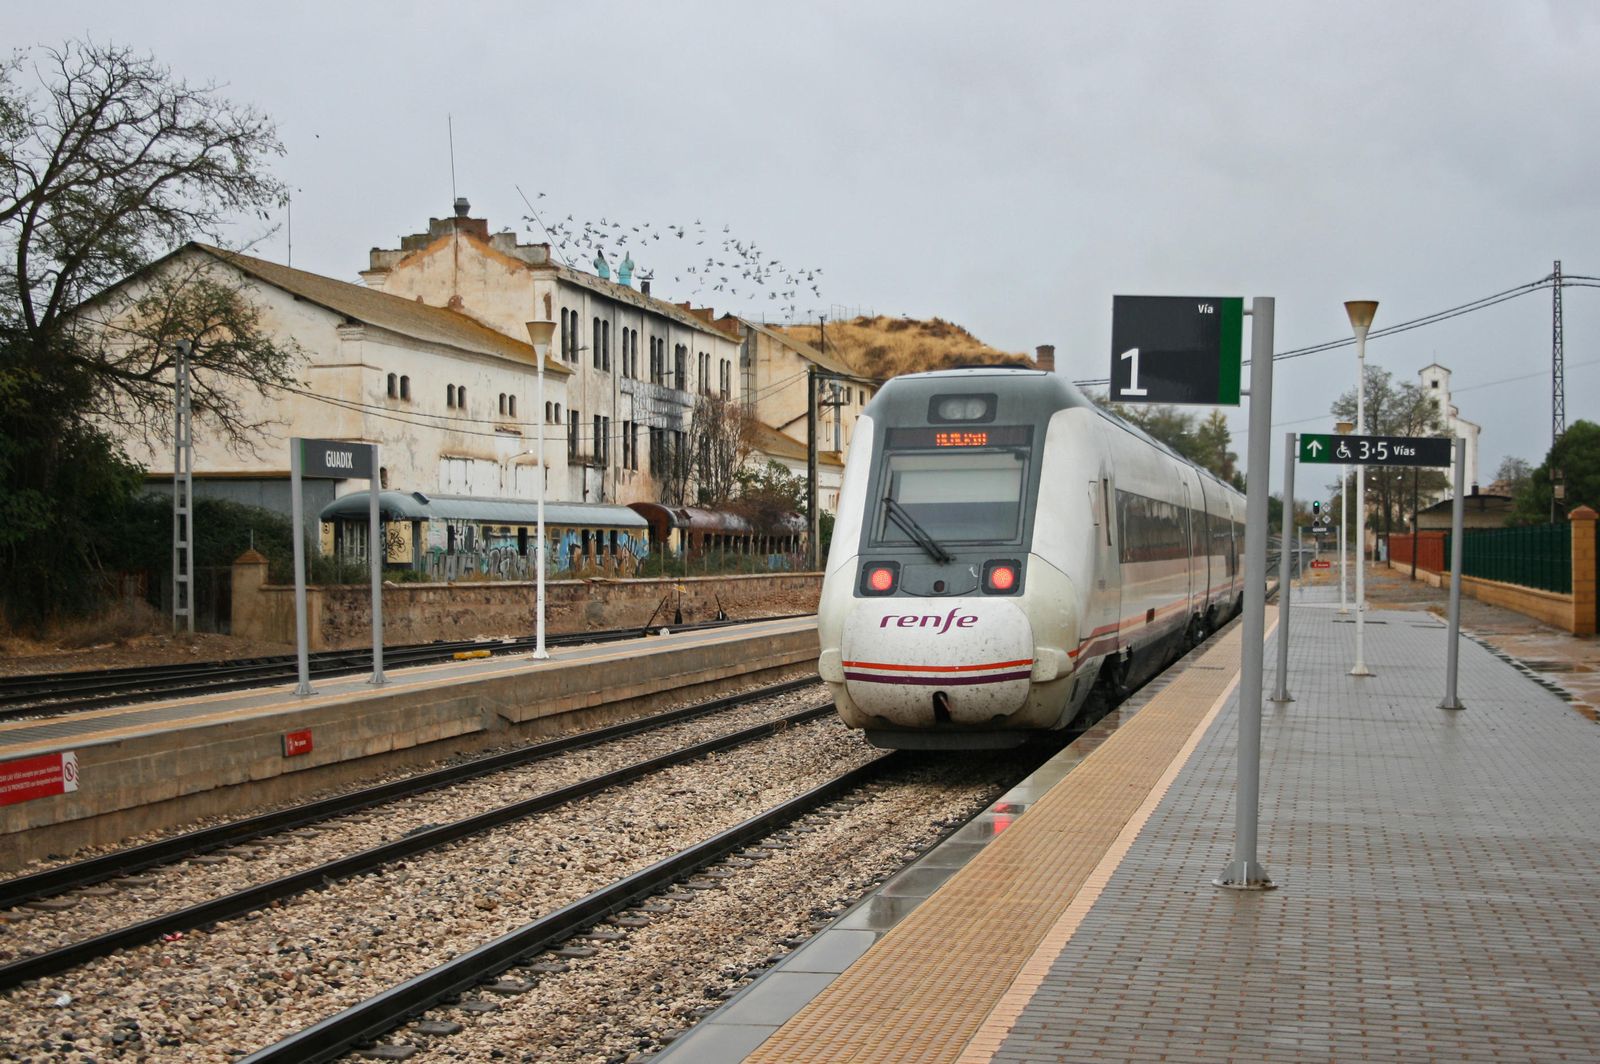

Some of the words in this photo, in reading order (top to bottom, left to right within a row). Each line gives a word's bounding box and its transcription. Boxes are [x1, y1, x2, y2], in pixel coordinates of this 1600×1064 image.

[1198, 304, 1214, 314] Vía
[1120, 348, 1148, 396] 1
[326, 450, 353, 469] GUADIX
[1393, 445, 1416, 456] Vías
[880, 607, 978, 635] renfe
